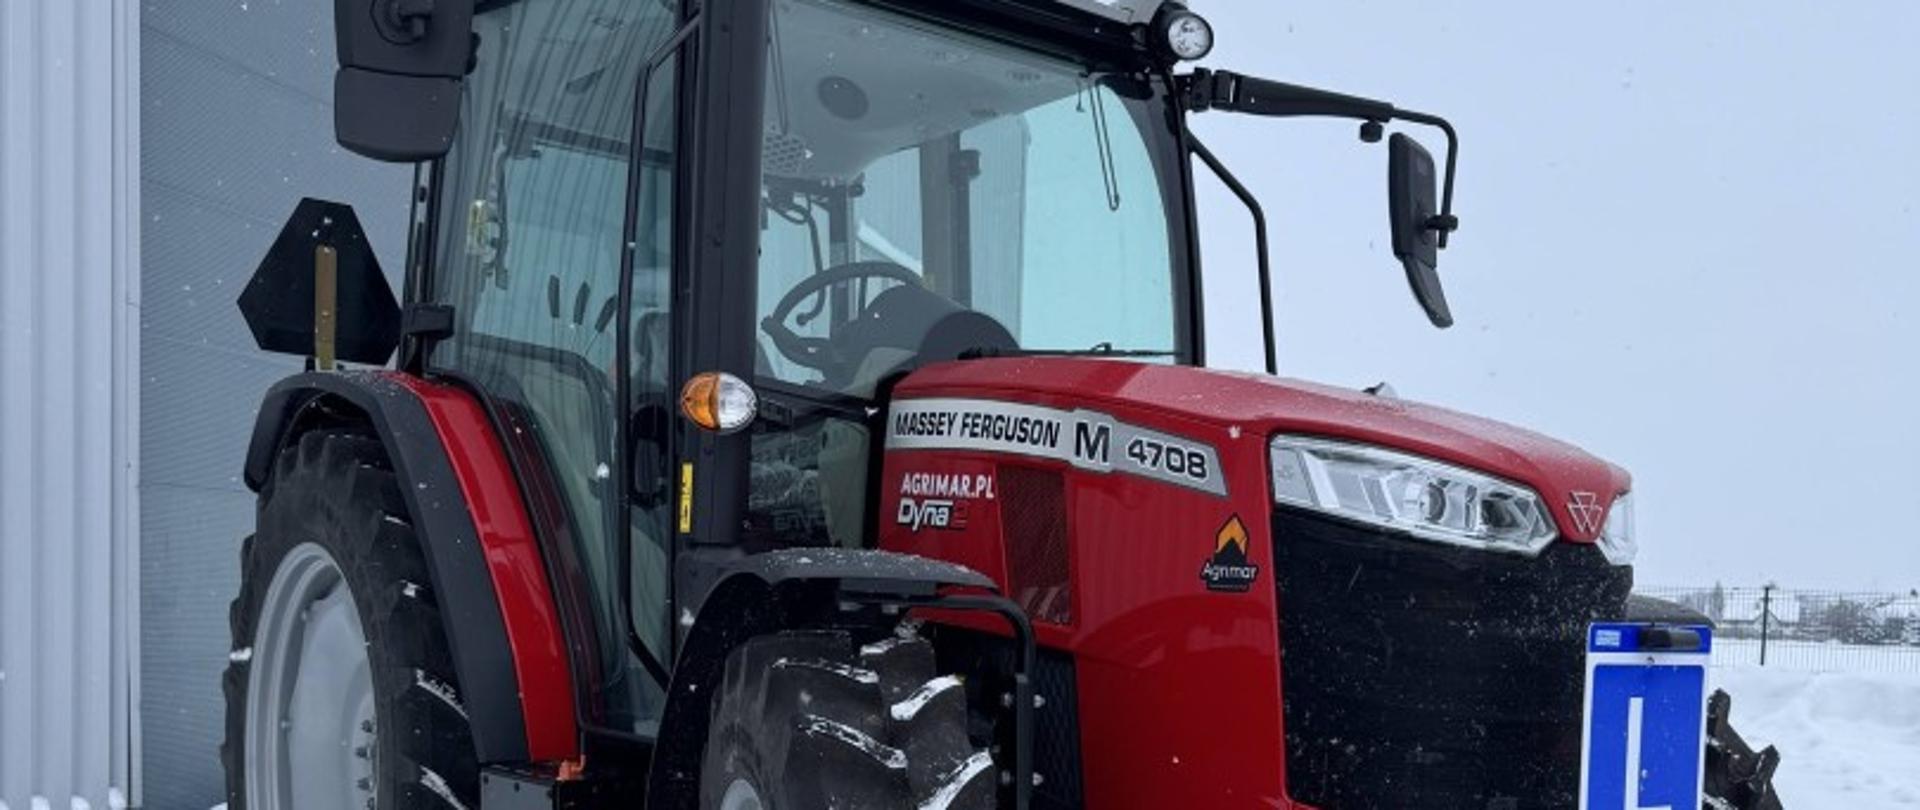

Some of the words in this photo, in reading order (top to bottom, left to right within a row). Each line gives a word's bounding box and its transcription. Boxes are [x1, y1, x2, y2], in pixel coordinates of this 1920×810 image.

[895, 411, 955, 436] MASSEY
[959, 412, 1061, 449] FERGUSON
[1074, 421, 1111, 463] M
[1127, 438, 1208, 479] 4708
[901, 472, 995, 499] AGRIMAR.PL
[1201, 561, 1257, 581] Agrimar
[1623, 696, 1672, 810] L
